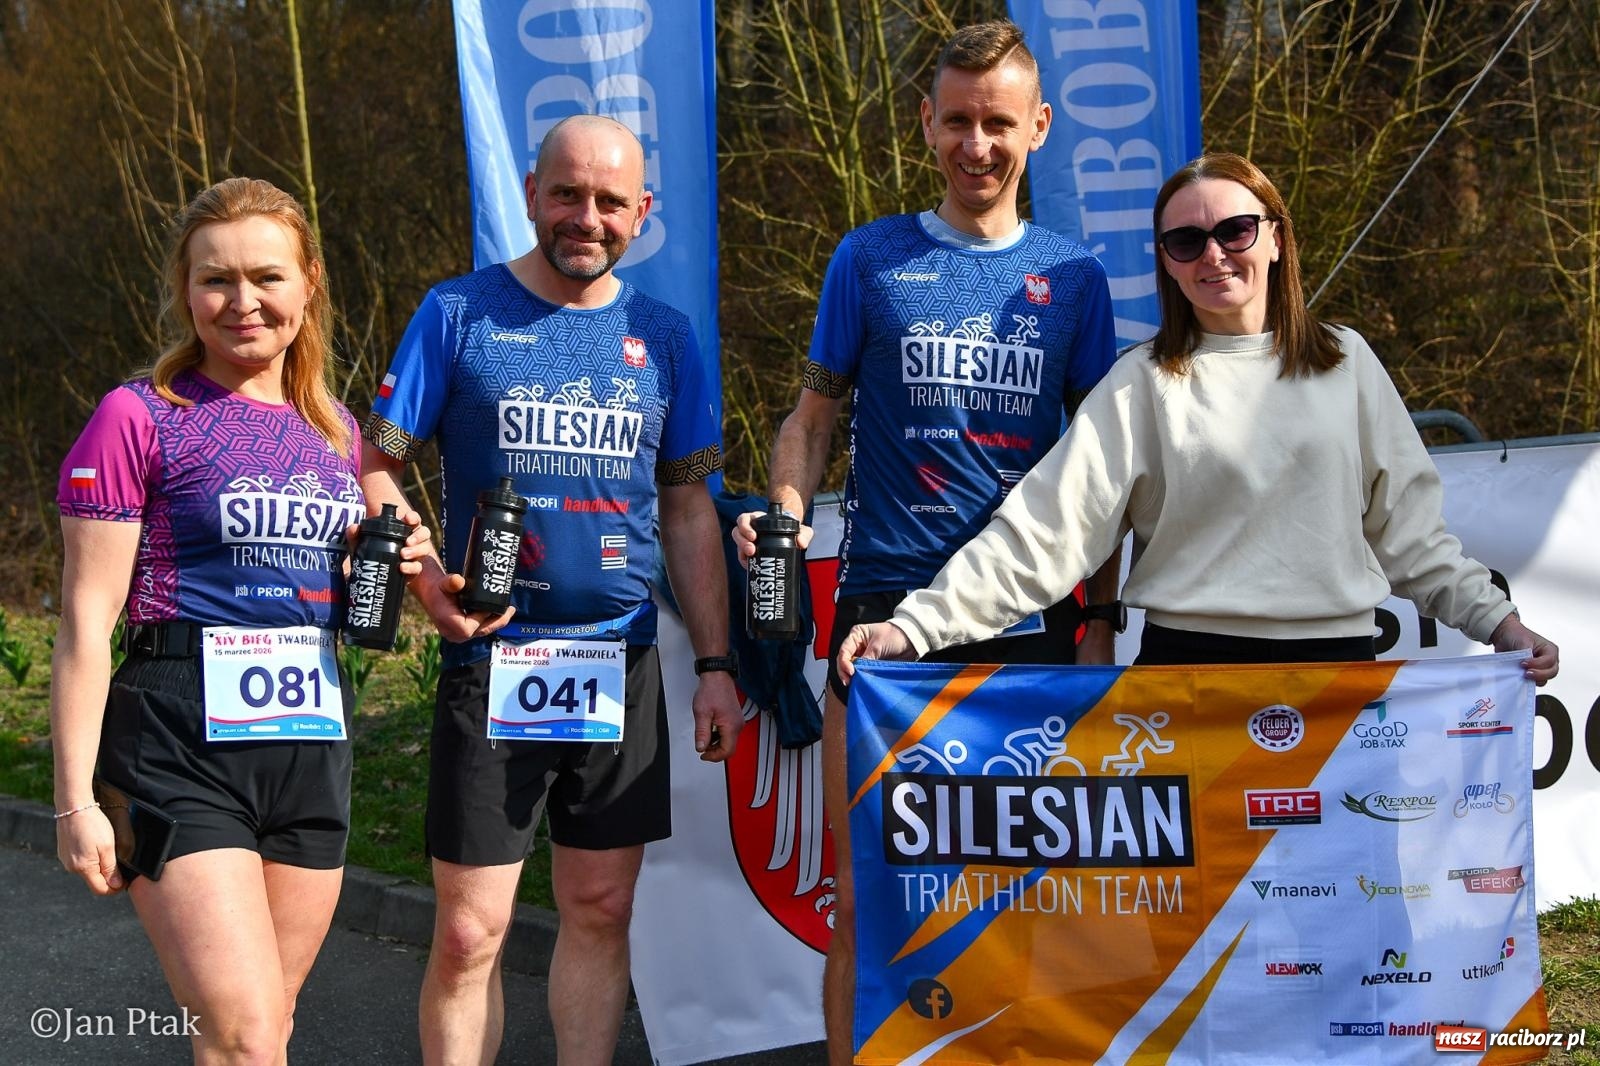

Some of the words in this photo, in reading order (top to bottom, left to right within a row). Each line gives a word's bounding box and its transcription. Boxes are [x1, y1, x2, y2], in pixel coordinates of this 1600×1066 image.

[905, 341, 1041, 390] SILESIAN
[909, 386, 992, 411] TRIATHLON
[996, 393, 1032, 416] TEAM
[503, 405, 639, 452] SILESIAN
[924, 428, 958, 439] PROFI
[505, 452, 592, 477] TRIATHLON
[596, 458, 631, 480] TEAM
[911, 505, 957, 513] ERIGO
[230, 545, 319, 571] TRIATHLON
[489, 530, 515, 594] SILESIAN
[503, 556, 517, 595] TRIATHLON
[511, 535, 521, 556] TEAM
[377, 563, 390, 584] TEAM
[776, 558, 786, 578] TEAM
[257, 587, 293, 598] PROFI
[353, 560, 379, 628] SILESIAN
[513, 579, 551, 591] RIGO
[759, 557, 776, 621] SILESIAN
[370, 585, 386, 628] TRIATHLON
[774, 578, 785, 620] TRIATHLON
[520, 626, 536, 634] XXX
[214, 634, 236, 646] XIV
[241, 633, 272, 646] BIEG
[224, 648, 251, 656] marzec
[501, 647, 520, 657] XIV
[524, 647, 550, 658] BIEG
[555, 648, 617, 660] TWARDZIELA
[239, 665, 322, 708] 081
[518, 675, 599, 714] 041
[1262, 717, 1290, 730] FELDER
[1265, 729, 1288, 737] GROUP
[1360, 739, 1379, 749] JOB
[1386, 739, 1406, 748] TAX
[1251, 795, 1316, 812] TRC
[1374, 795, 1437, 811] REKPOL
[1470, 801, 1493, 810] KOŁO
[892, 782, 1185, 858] SILESIAN
[1452, 868, 1490, 876] STUDIO
[1272, 883, 1337, 897] manavi
[1471, 877, 1518, 889] EFEKT
[897, 873, 1082, 915] TRIATHLON
[1094, 874, 1184, 915] TEAM
[1462, 961, 1504, 980] utikom
[1351, 1025, 1383, 1034] PROFI
